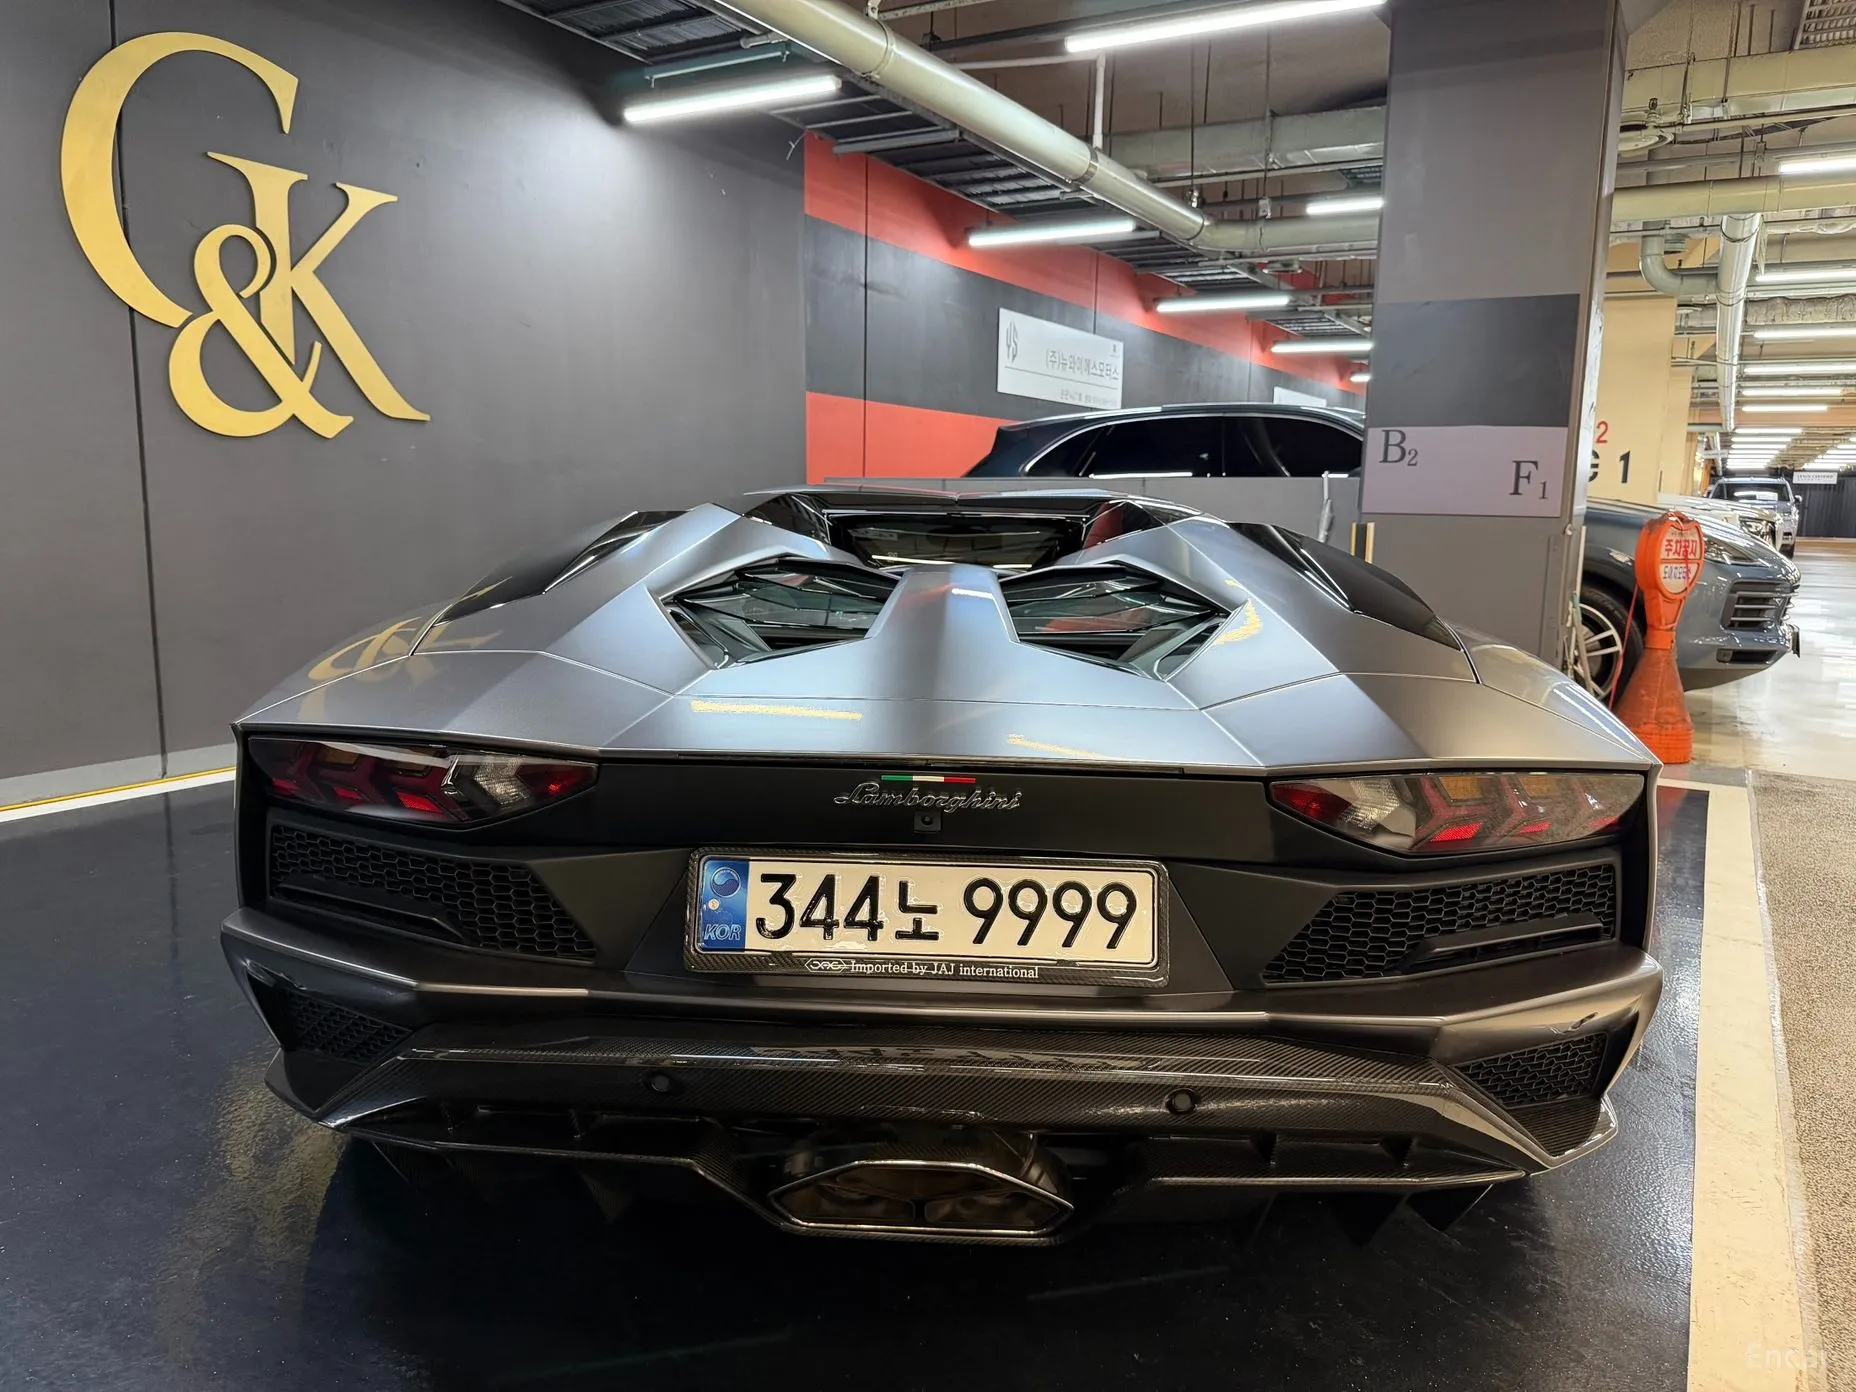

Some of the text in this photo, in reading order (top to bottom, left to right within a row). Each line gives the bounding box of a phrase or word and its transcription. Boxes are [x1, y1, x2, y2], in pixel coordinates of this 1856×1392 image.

[59, 31, 431, 439] G&K
[834, 782, 1022, 812] Lamborghini
[755, 873, 1138, 950] 344노 9999
[704, 924, 742, 941] KOR
[850, 960, 907, 974] Imported
[912, 961, 927, 976] by
[931, 962, 955, 975] JAJ
[959, 963, 1039, 979] international
